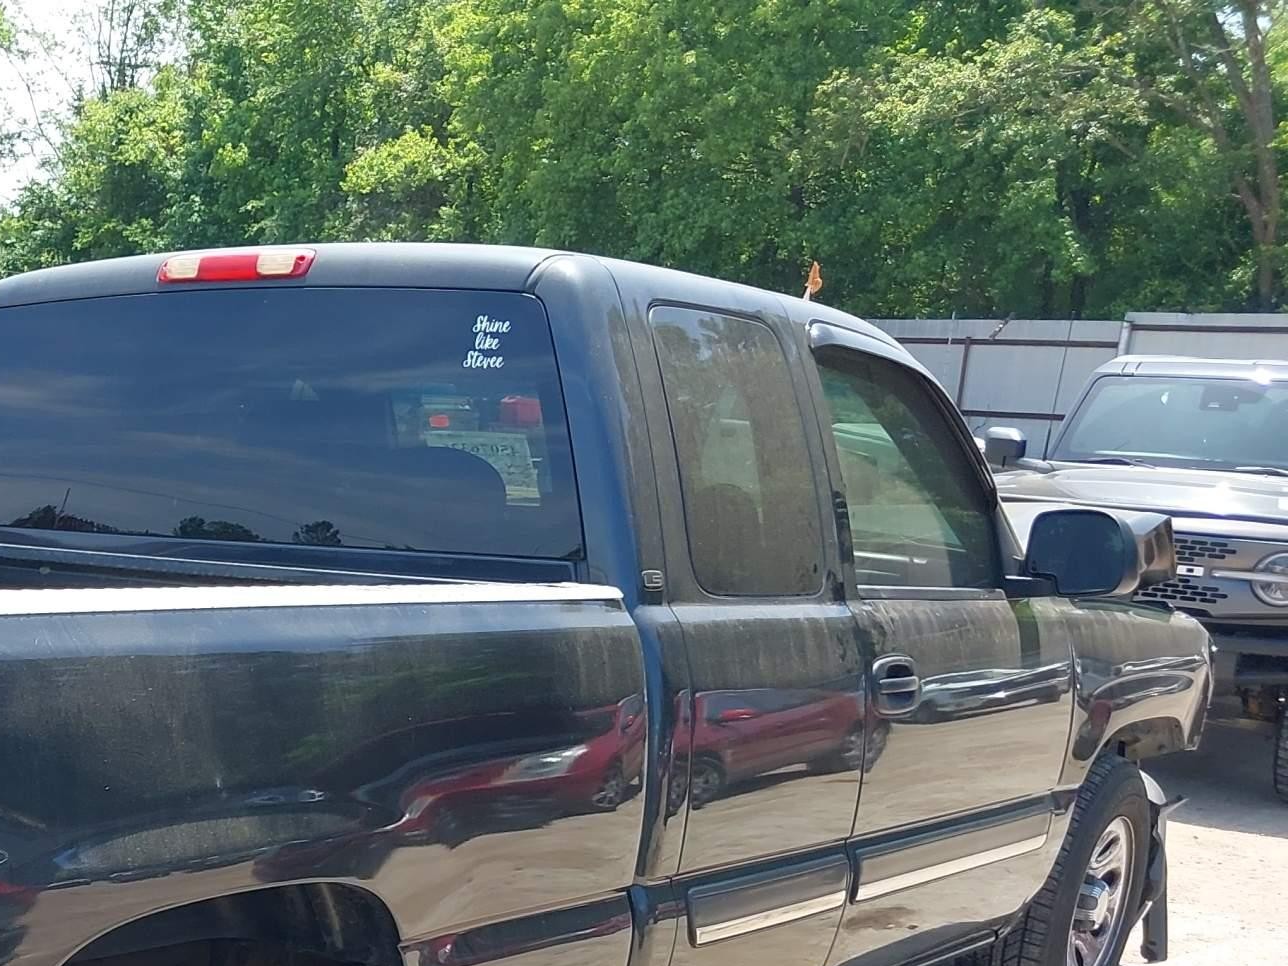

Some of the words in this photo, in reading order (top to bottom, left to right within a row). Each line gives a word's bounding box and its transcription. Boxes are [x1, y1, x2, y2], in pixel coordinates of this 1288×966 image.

[472, 314, 512, 333] Shine
[475, 331, 501, 350] like
[462, 350, 505, 369] Stevee
